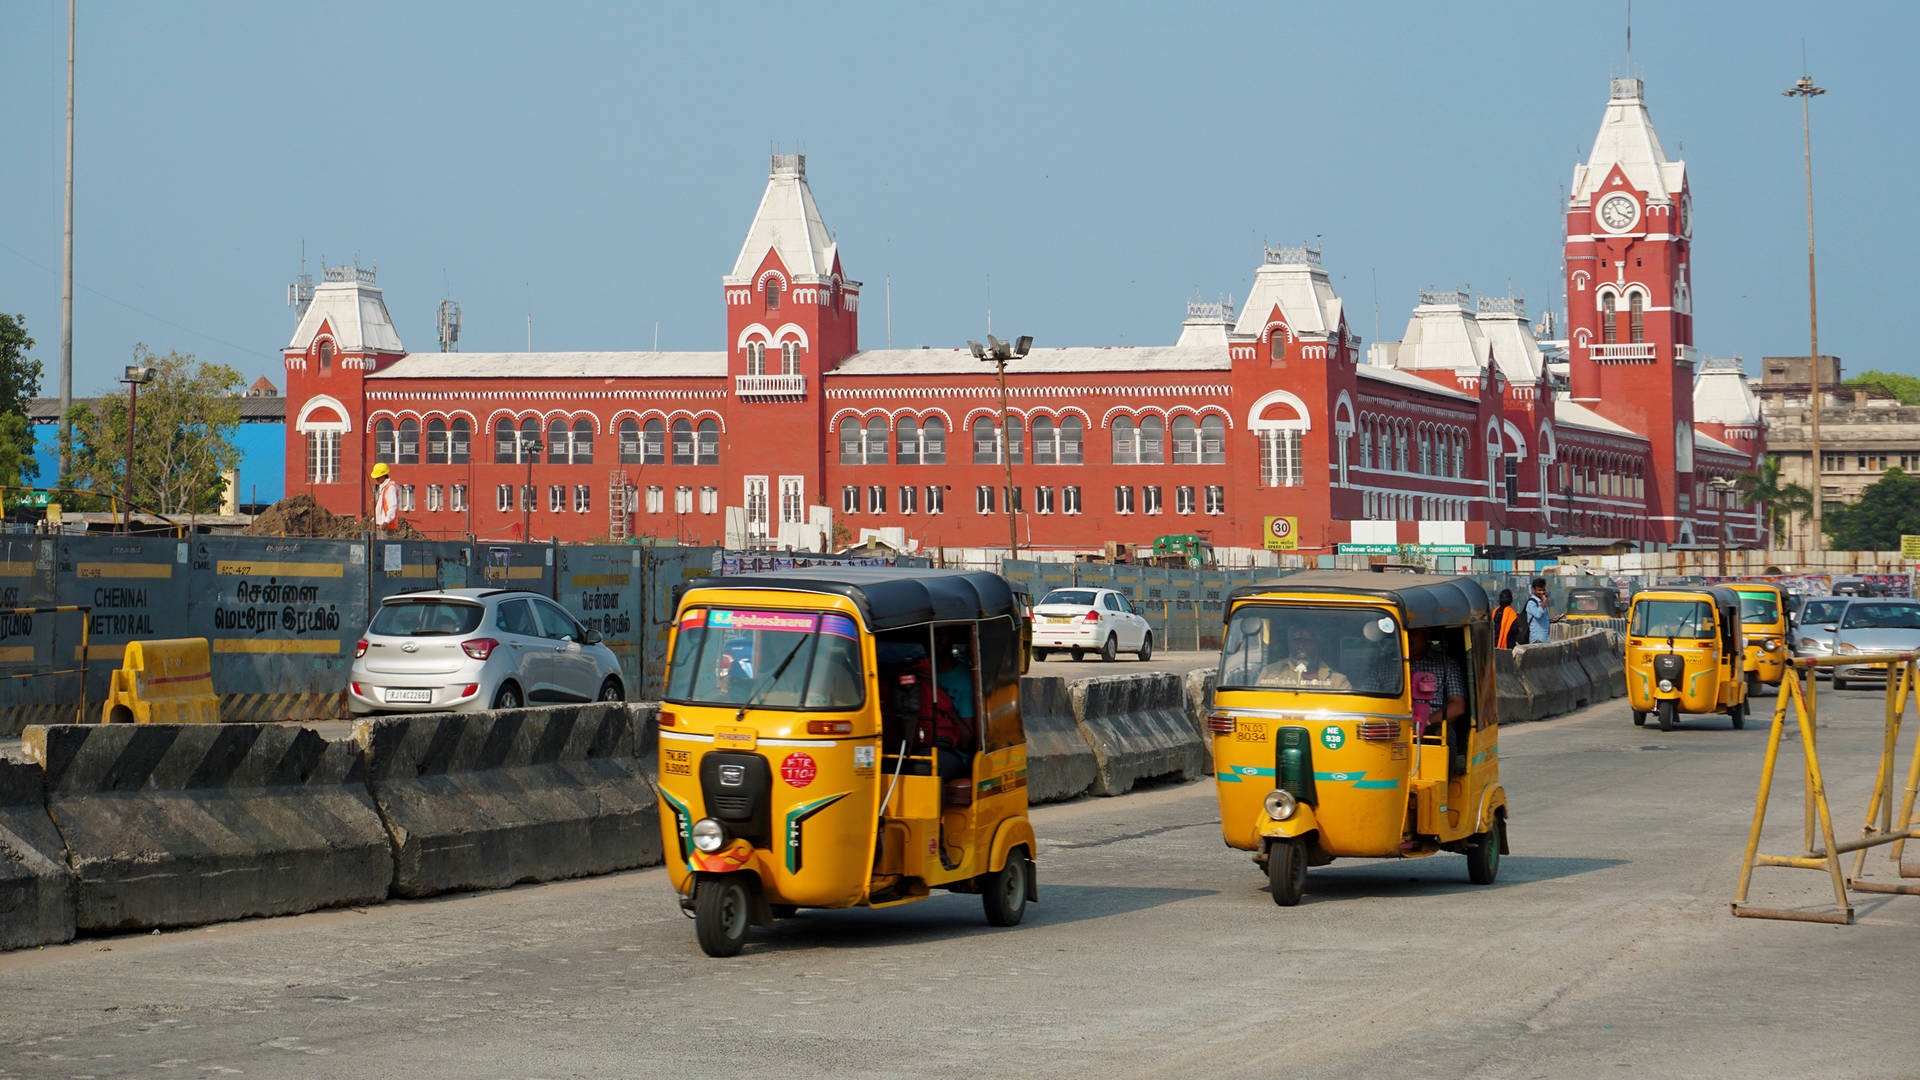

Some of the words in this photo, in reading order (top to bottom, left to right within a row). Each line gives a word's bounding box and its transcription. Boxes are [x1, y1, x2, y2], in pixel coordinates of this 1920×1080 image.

[1274, 522, 1288, 533] 30
[94, 587, 147, 609] CHENNAI
[128, 613, 154, 636] RAIL
[1326, 726, 1340, 735] NE
[1238, 732, 1267, 742] 8034
[1325, 734, 1341, 743] 938
